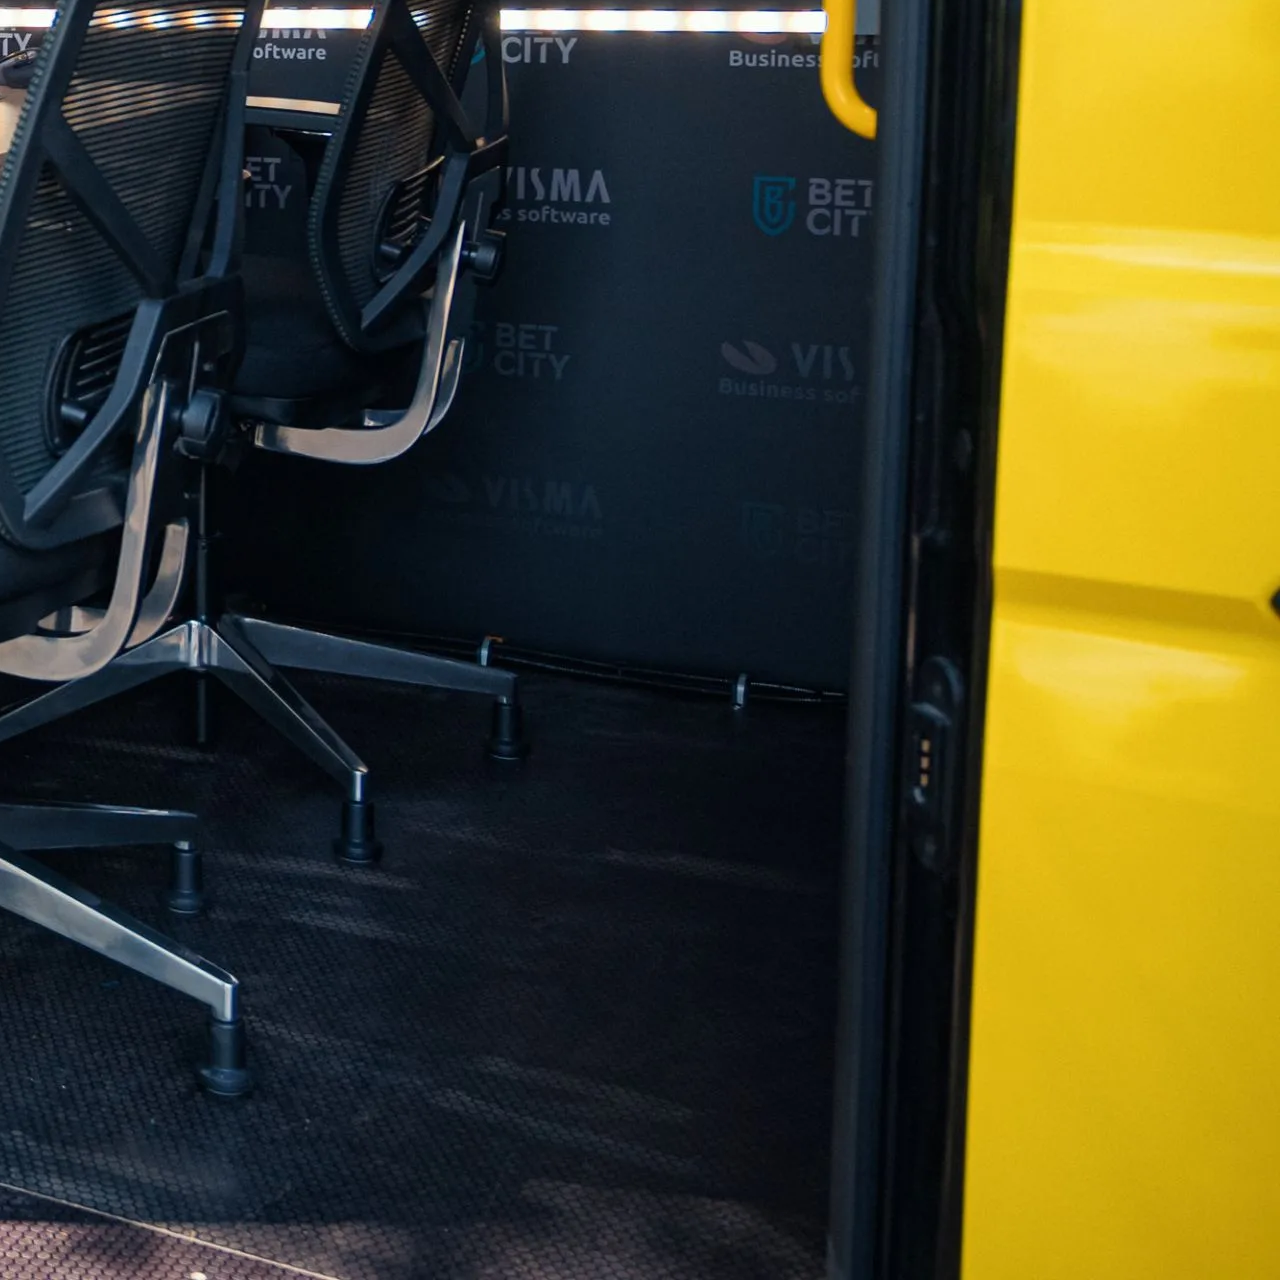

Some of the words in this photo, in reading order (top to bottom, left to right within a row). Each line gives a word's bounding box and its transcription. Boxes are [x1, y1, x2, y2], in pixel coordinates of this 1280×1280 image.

[252, 41, 327, 61] oftware
[501, 37, 578, 64] CITY
[245, 156, 282, 182] ET
[245, 183, 293, 209] ITY
[507, 167, 611, 203] ISMA
[809, 178, 873, 207] BET
[518, 205, 611, 225] software
[806, 208, 873, 237] CIT
[495, 322, 559, 351] BET
[494, 350, 571, 381] CITY
[791, 341, 855, 381] VIS
[719, 378, 816, 401] Business
